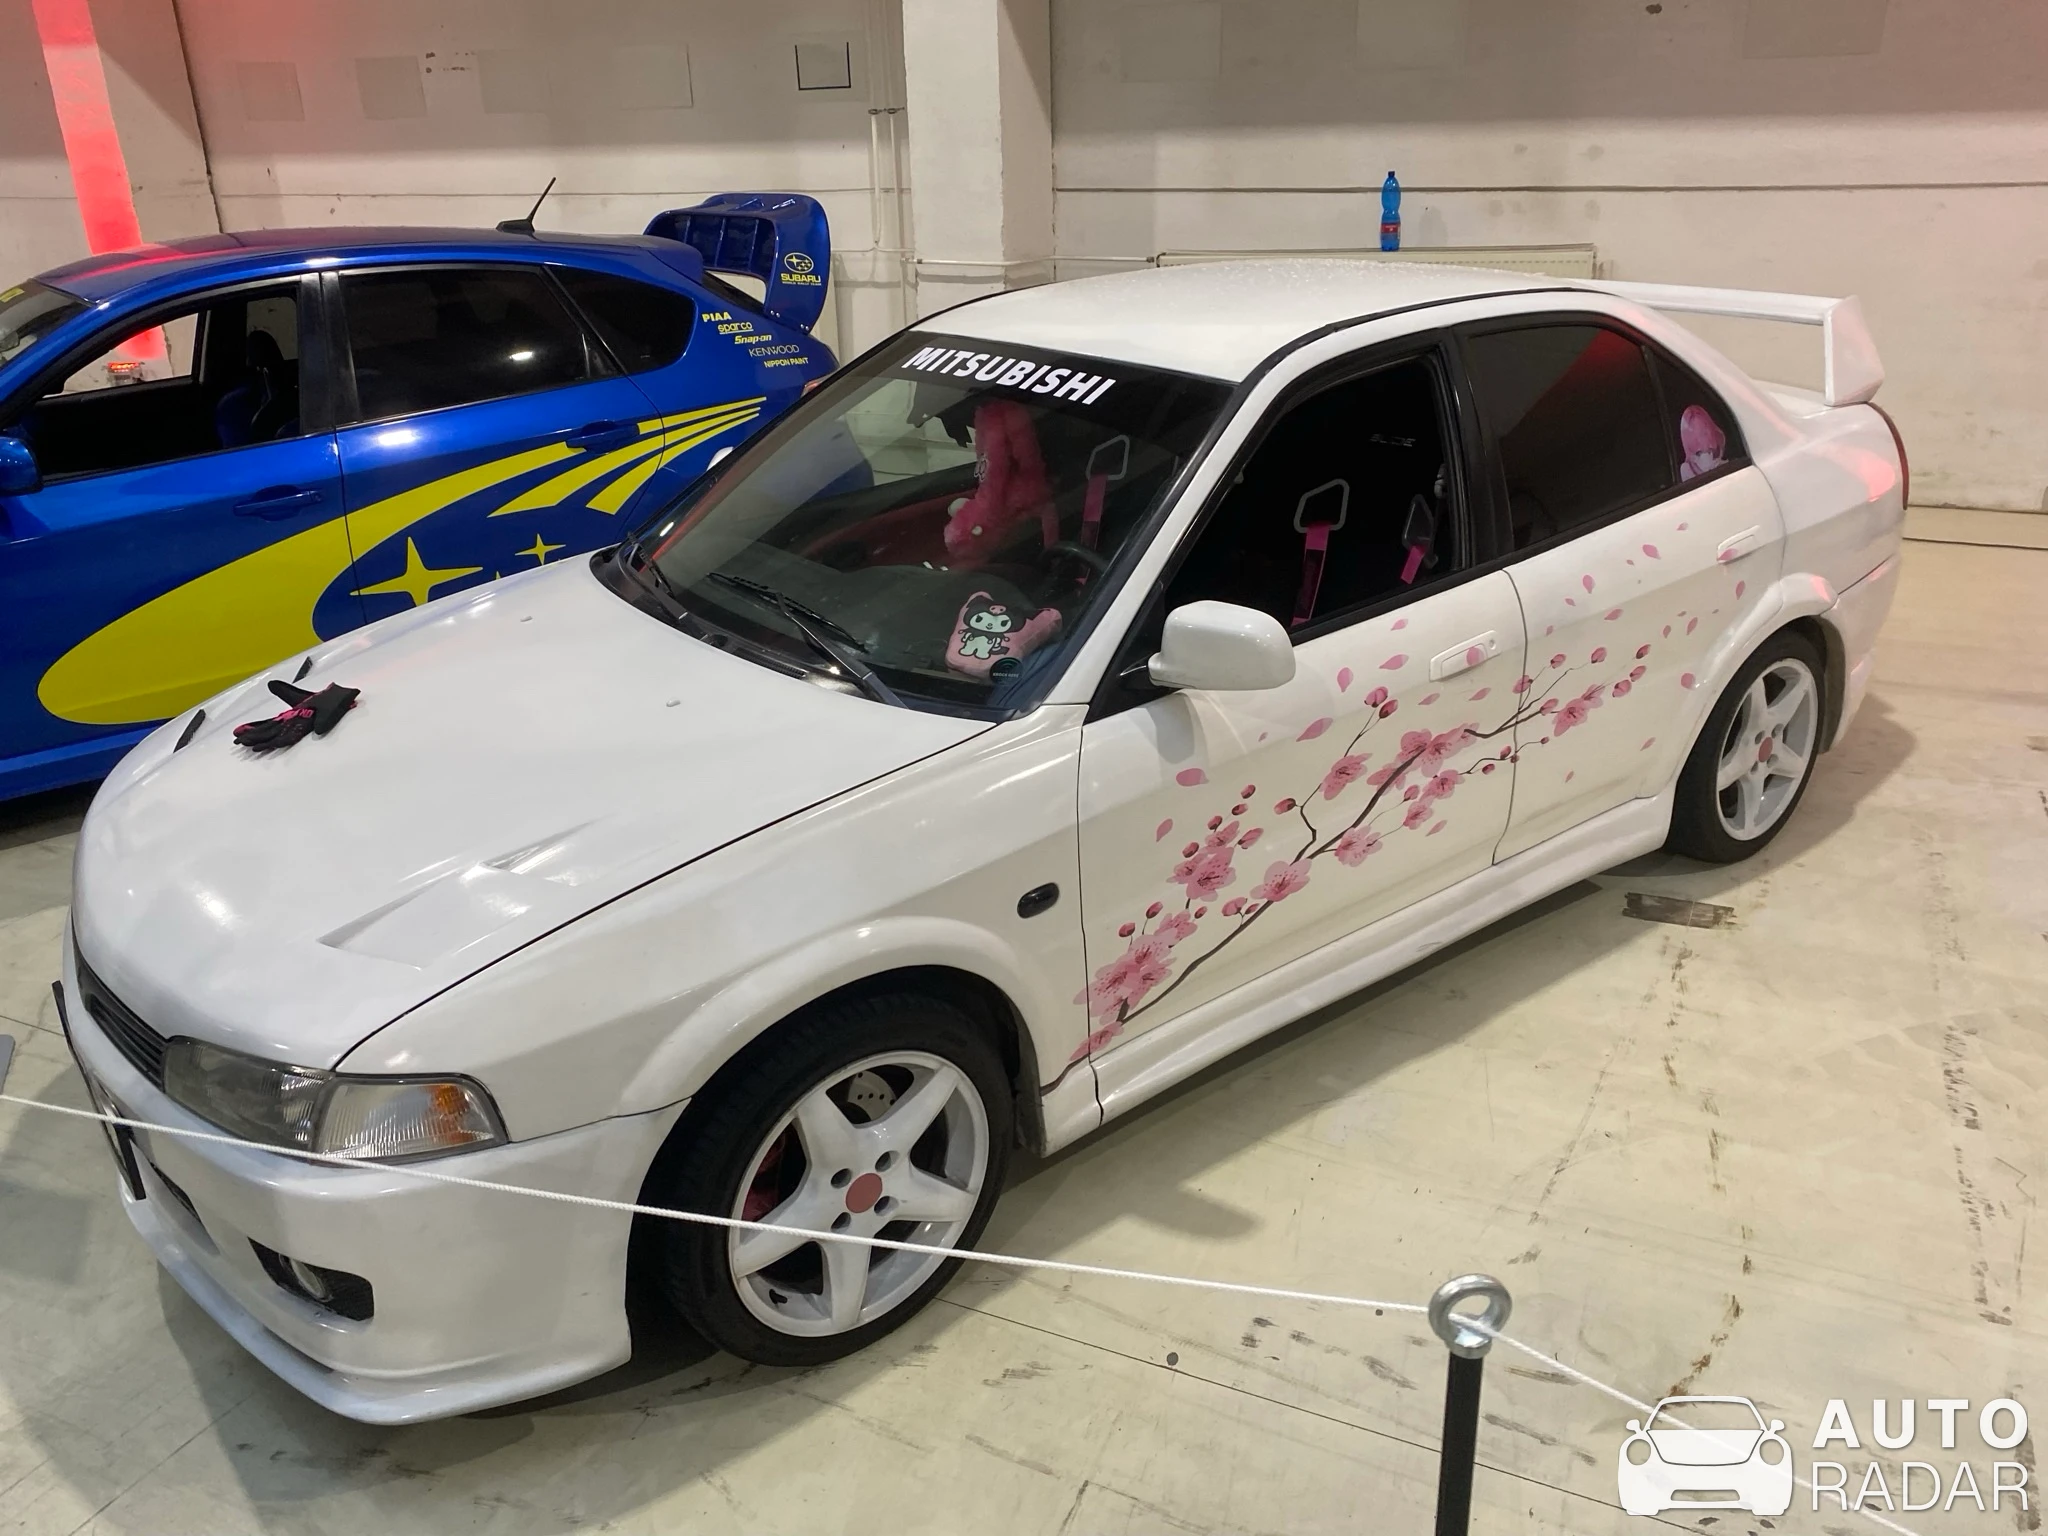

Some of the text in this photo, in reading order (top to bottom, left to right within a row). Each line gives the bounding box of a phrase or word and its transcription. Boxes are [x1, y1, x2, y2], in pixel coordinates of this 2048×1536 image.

[781, 273, 821, 283] SUBARU
[702, 312, 732, 322] PIAA
[717, 322, 754, 334] sparco
[734, 335, 772, 344] Snap-on
[748, 345, 800, 357] KENWOOD
[764, 357, 809, 368] NIPPON PAINT
[901, 346, 1117, 405] MITSUBISHI
